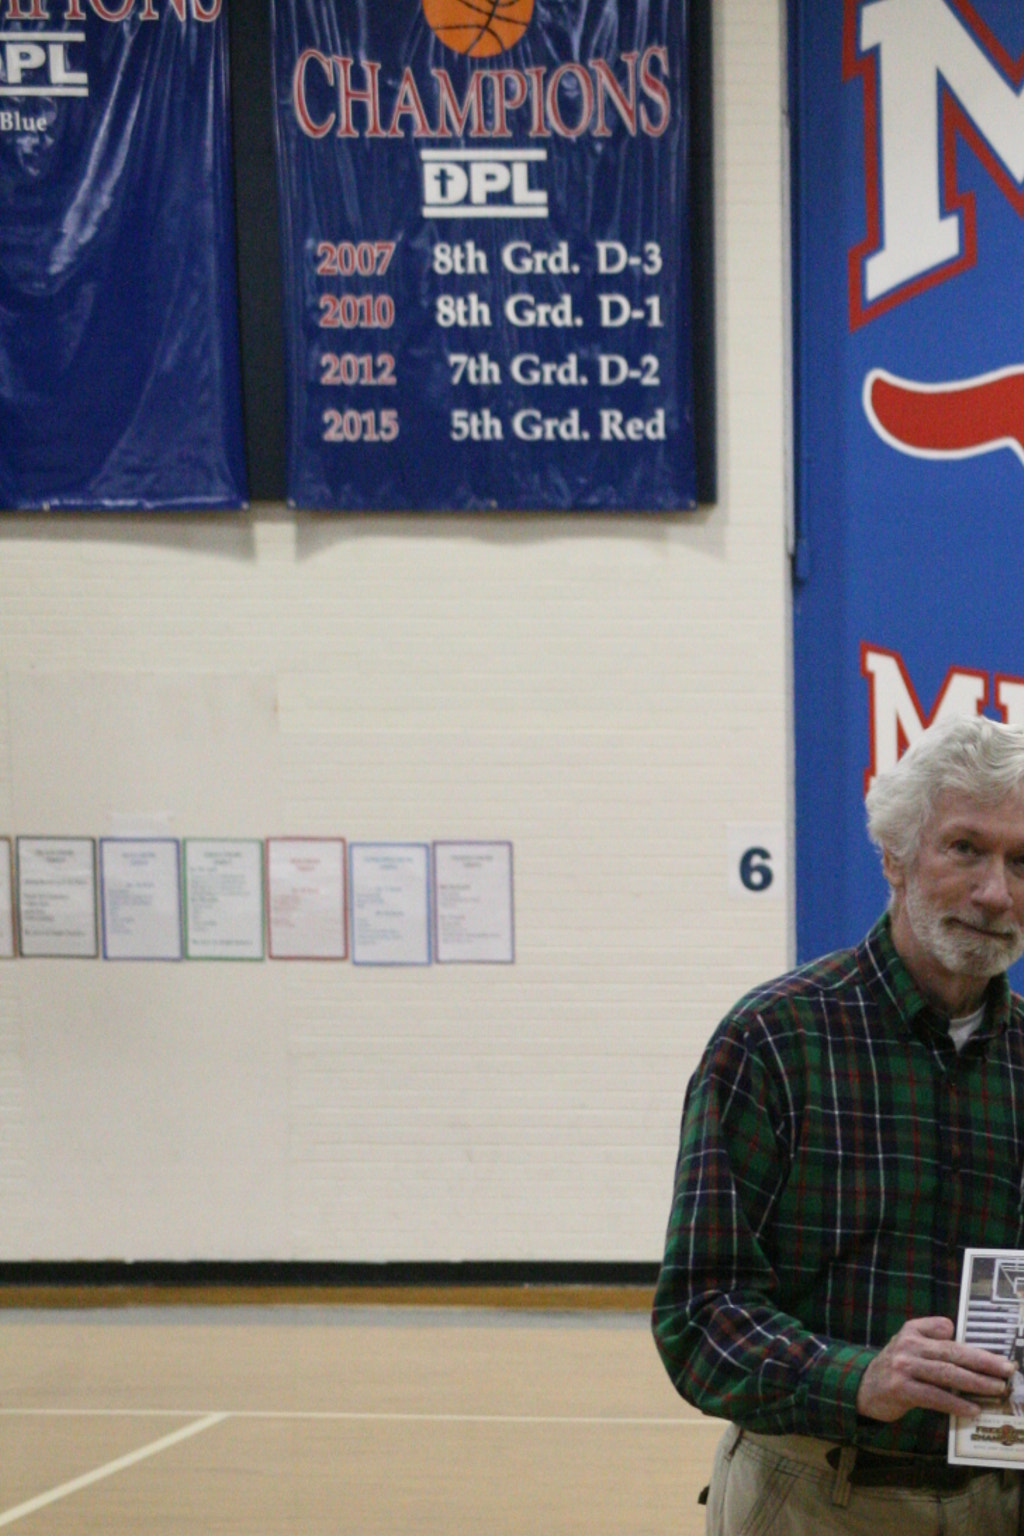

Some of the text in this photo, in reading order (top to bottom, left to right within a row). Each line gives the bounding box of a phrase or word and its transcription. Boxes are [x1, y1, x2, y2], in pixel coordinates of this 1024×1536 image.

[0, 43, 88, 84] PL
[293, 46, 671, 138] CHAMPIONS
[0, 110, 48, 131] Blue
[422, 160, 548, 207] DPL
[316, 240, 663, 275] 2007 8th Grd. D-3
[318, 293, 664, 328] 2010 8th Grd. D-1
[320, 353, 661, 386] 2012 7th Grd. D-2
[322, 407, 666, 442] 2015 5th Grd. Red
[739, 845, 774, 893] 6
